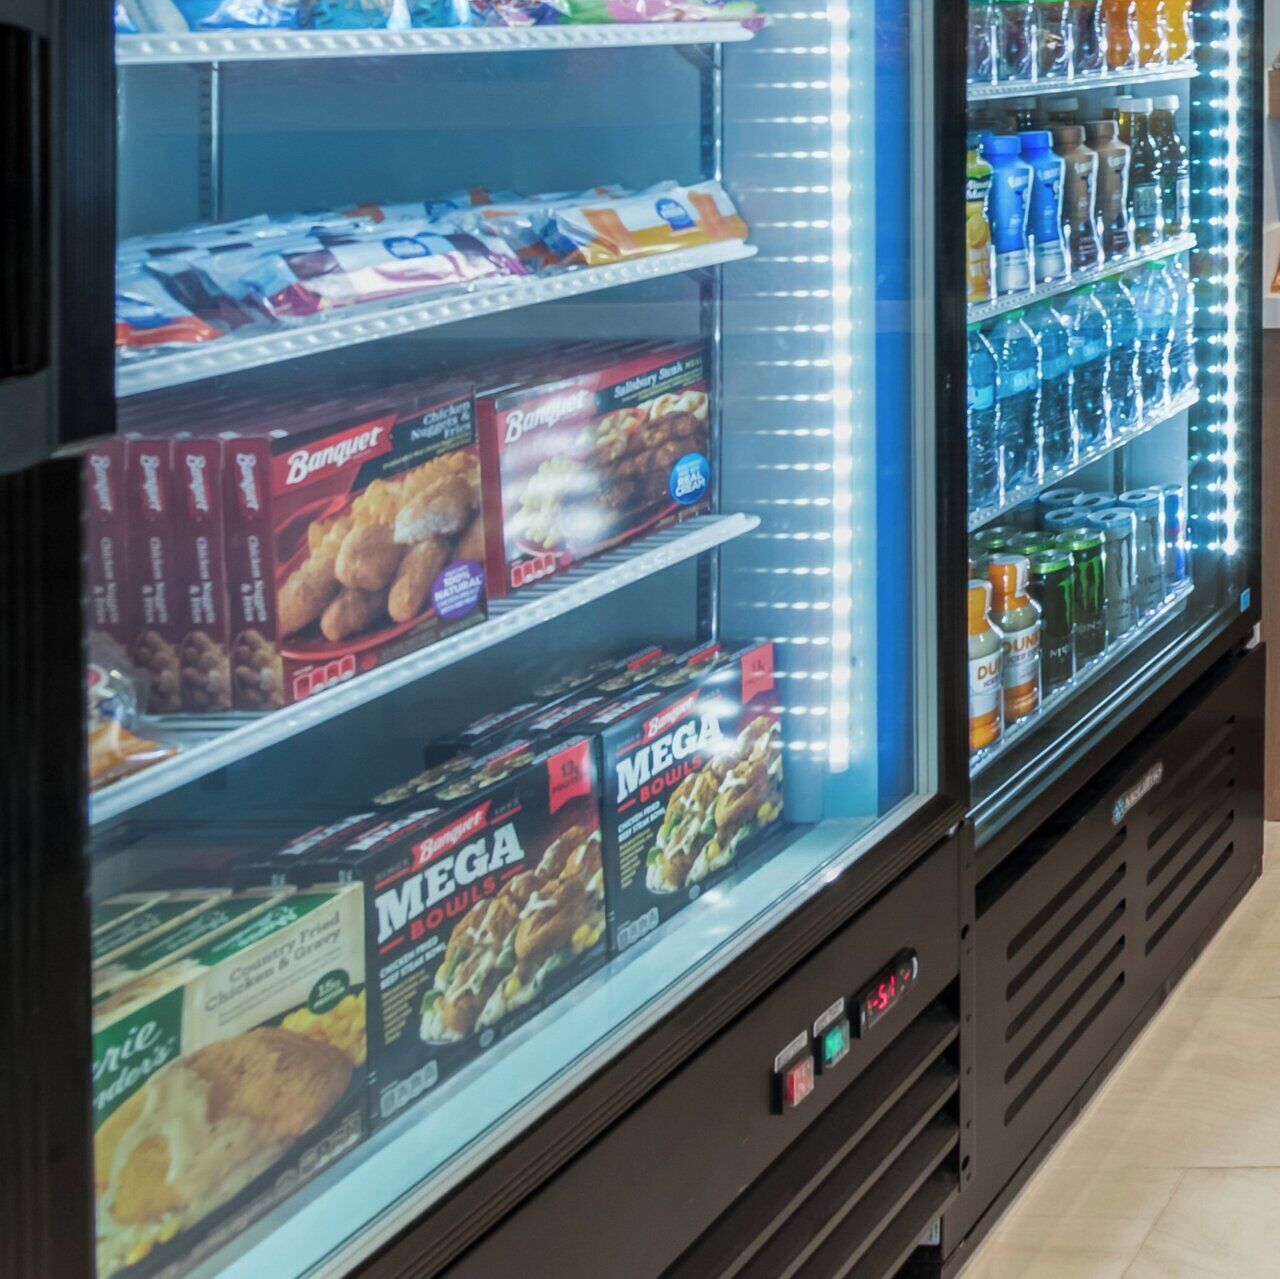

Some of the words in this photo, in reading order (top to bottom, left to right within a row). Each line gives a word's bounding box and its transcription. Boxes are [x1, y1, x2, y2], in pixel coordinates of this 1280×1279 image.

[614, 374, 658, 399] Salisbury
[659, 361, 683, 381] Steak
[285, 424, 386, 485] Banquet
[616, 712, 724, 804] MEGA
[640, 757, 702, 803] BOWLS
[419, 810, 484, 864] Banquet
[375, 821, 525, 945] MEGA
[410, 875, 496, 940] BOWLS
[204, 967, 275, 1012] Chicken
[293, 928, 341, 960] Gravy
[229, 938, 296, 983] Country
[300, 910, 340, 943] Fried
[92, 1020, 164, 1082] rie
